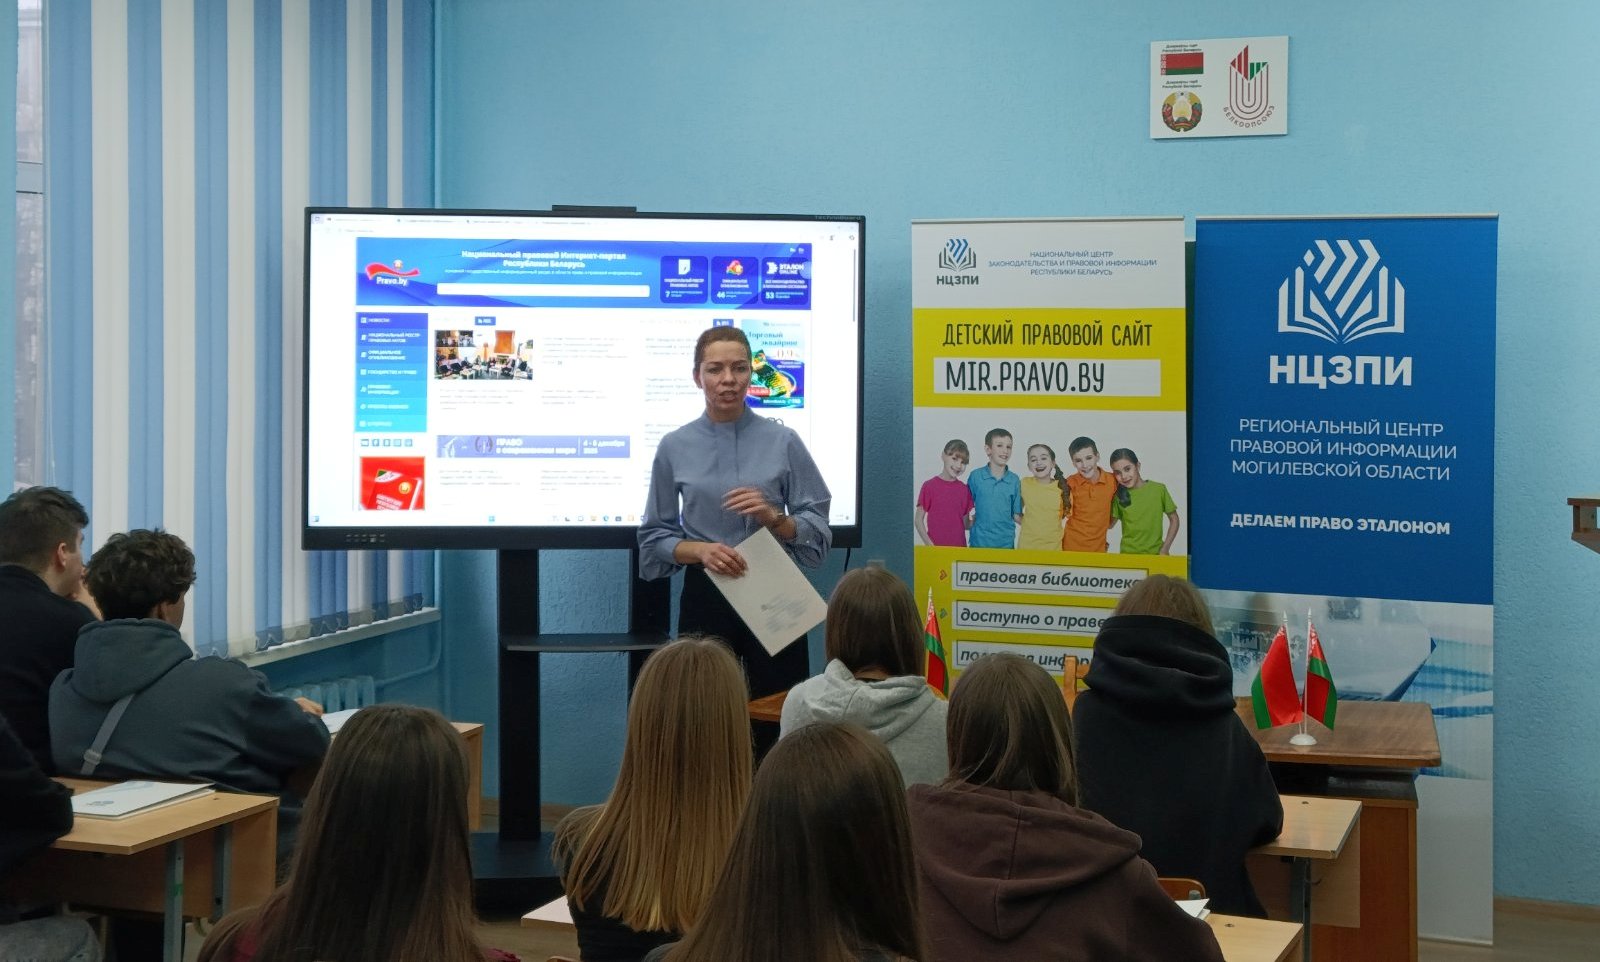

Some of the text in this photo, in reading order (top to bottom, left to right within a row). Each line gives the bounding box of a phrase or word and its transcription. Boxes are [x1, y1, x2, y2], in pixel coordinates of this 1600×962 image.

[1223, 105, 1275, 128] БЕЛКООПСОЮЗ
[1030, 250, 1113, 259] НАЦИОНАЛЬНЫЙ ЦЕНТР
[1066, 259, 1103, 267] ПРАВОВОЙ
[1105, 259, 1157, 267] ИНФОРМАЦИИ
[376, 276, 408, 285] Pravo.by
[936, 275, 979, 286] НЦЗПИ
[942, 320, 1153, 347] ДЕТСКИЙ ПРАВОВОЙ САЙТ
[945, 361, 1105, 393] MIR.PRAVO.BY
[1269, 355, 1413, 389] НЦЗПИ
[1239, 418, 1444, 437] РЕГИОНАЛЬНЫЙ ЦЕНТР
[1230, 439, 1457, 460] ПРАВОВОЙ ИНФОРМАЦИИ
[1232, 460, 1450, 481] МОГИЛЕВСКОЙ ОБЛАСТИ
[1230, 513, 1450, 535] ДЕЛАЕМ ПРАВО ЭТАЛОНОМ
[960, 570, 1037, 585] правовая
[960, 608, 1040, 629] доступно
[1044, 616, 1054, 625] о
